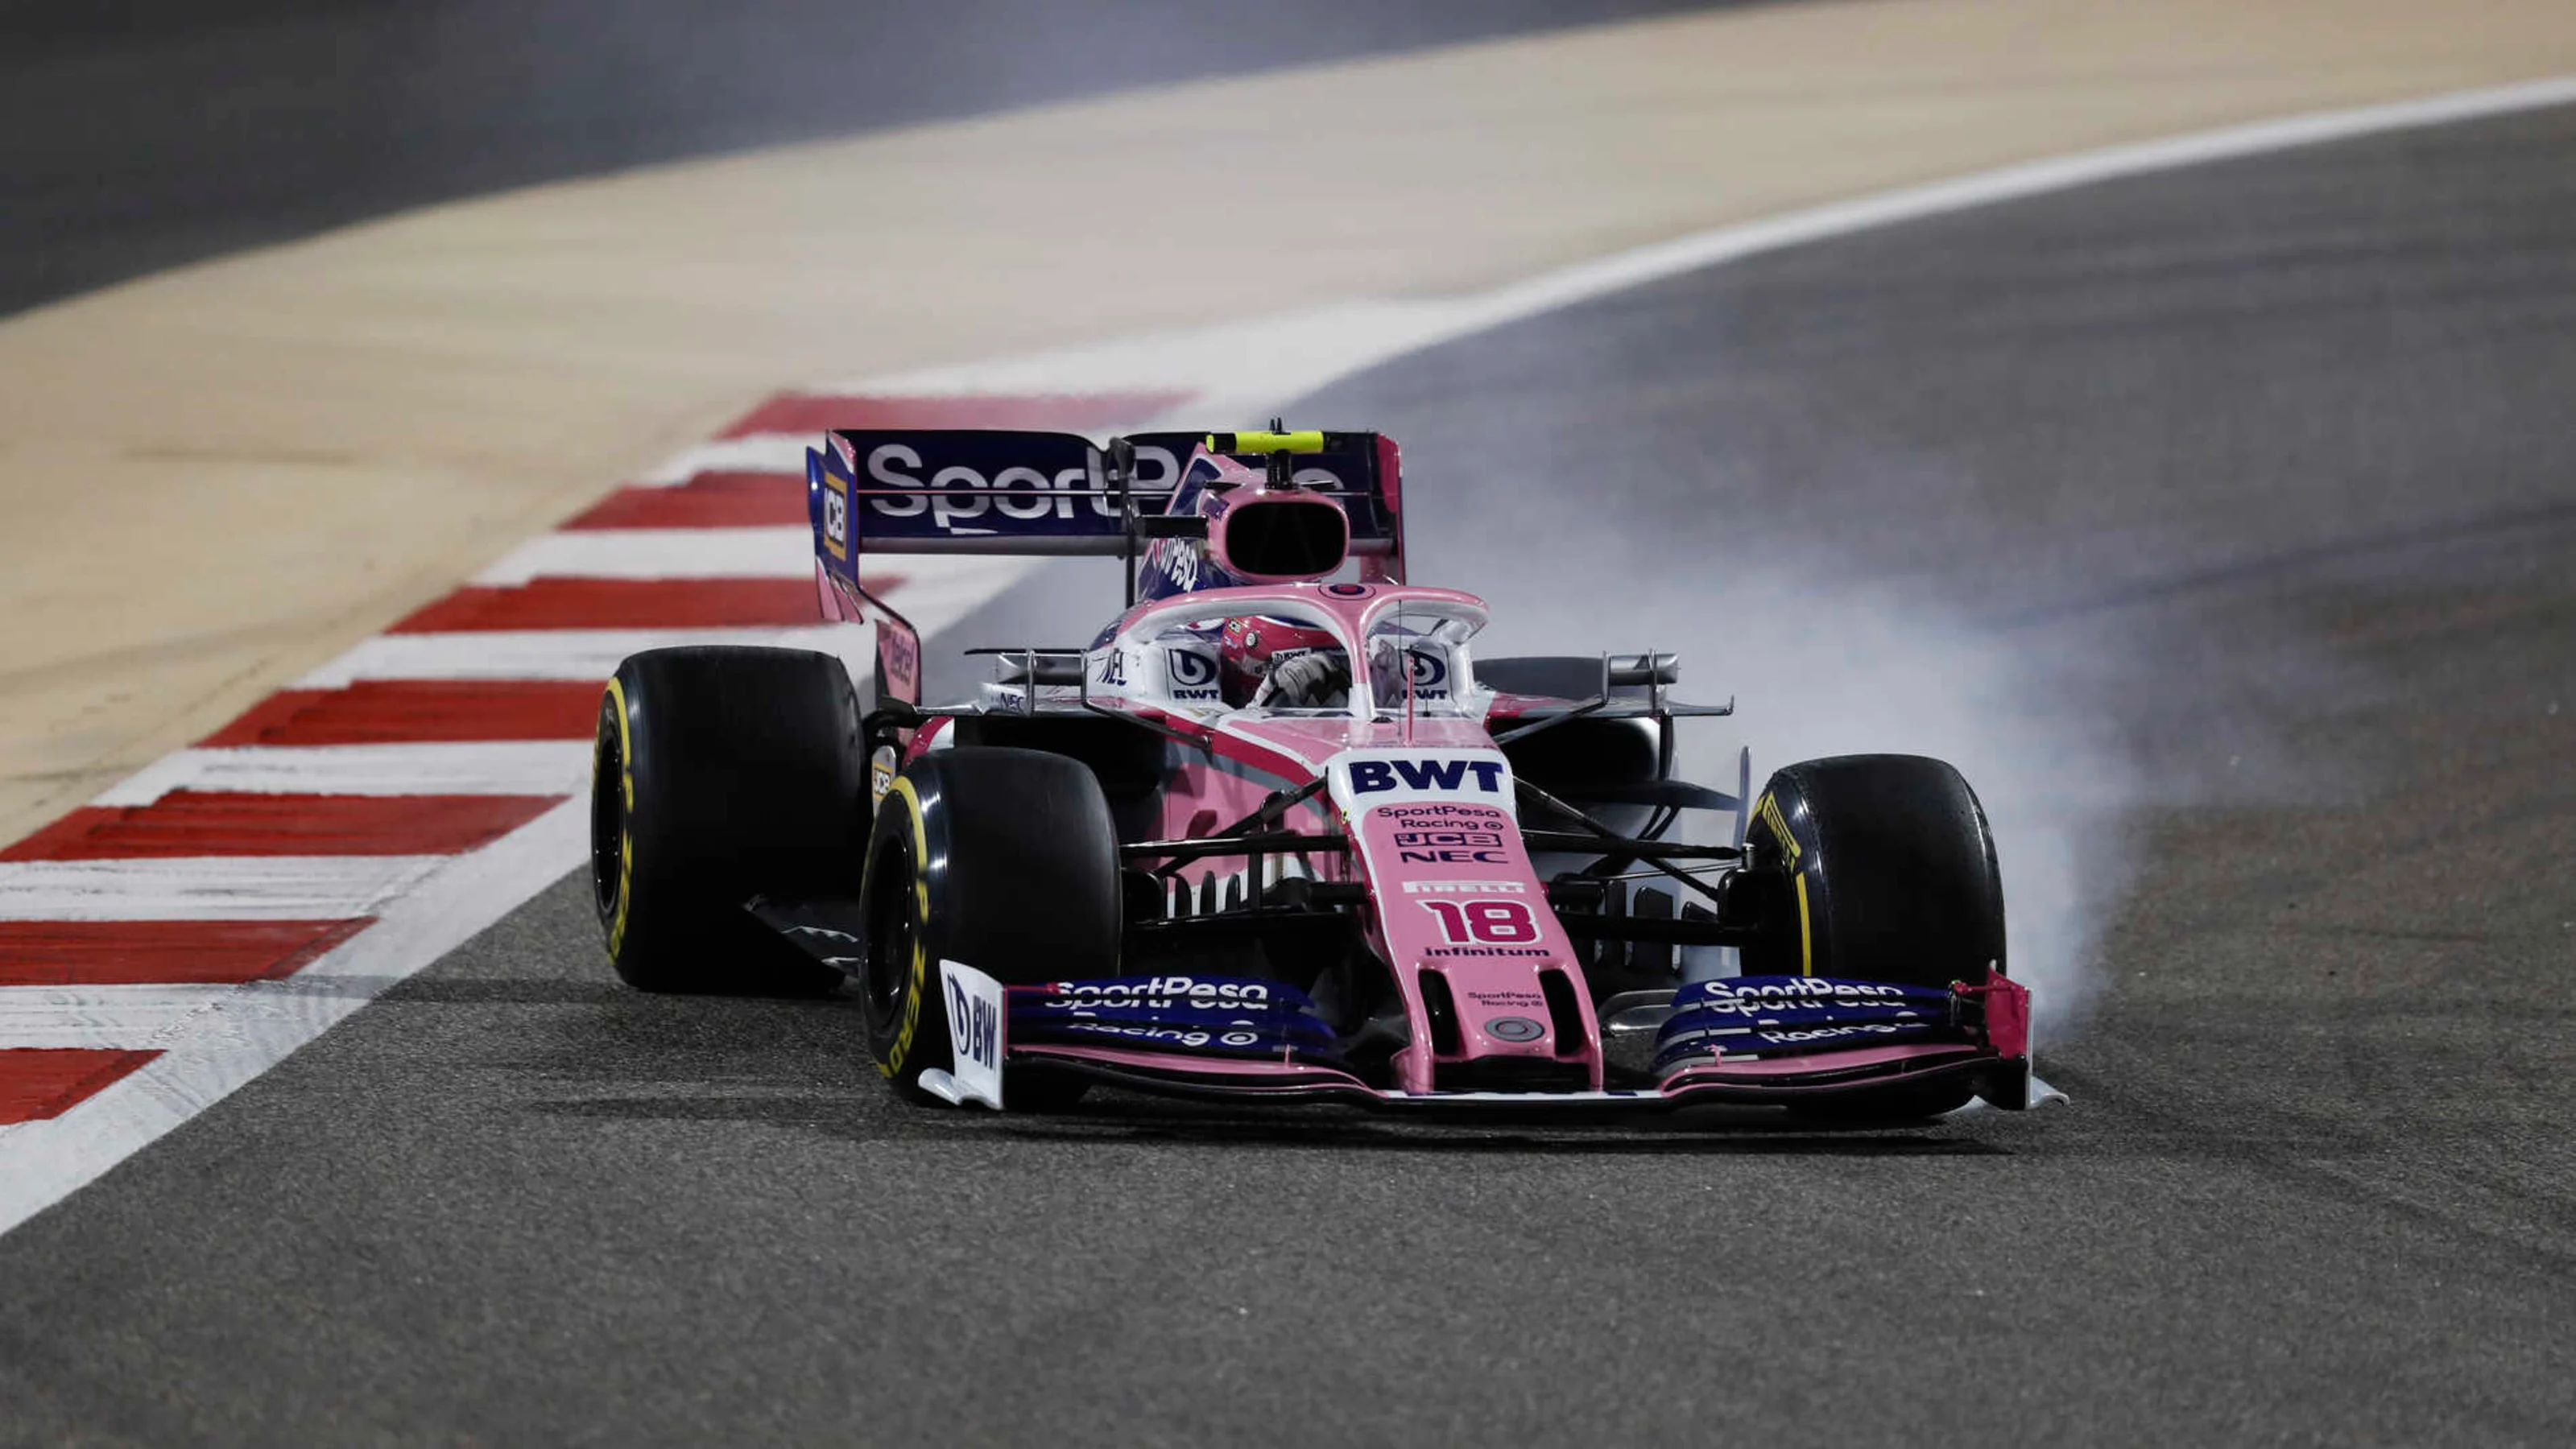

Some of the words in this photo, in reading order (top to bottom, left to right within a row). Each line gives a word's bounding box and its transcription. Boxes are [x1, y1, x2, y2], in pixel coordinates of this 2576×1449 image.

[1172, 689, 1218, 700] BWT
[1348, 760, 1505, 795] BWT
[1377, 806, 1501, 819] SportPesa
[1400, 819, 1479, 830] Racing
[1394, 832, 1503, 847] JCB
[1400, 850, 1509, 864] NEC
[1402, 880, 1527, 894] PIRELLI
[1414, 899, 1543, 945] 18
[1424, 947, 1551, 957] infinitum
[1045, 976, 1269, 1011] SportPesa
